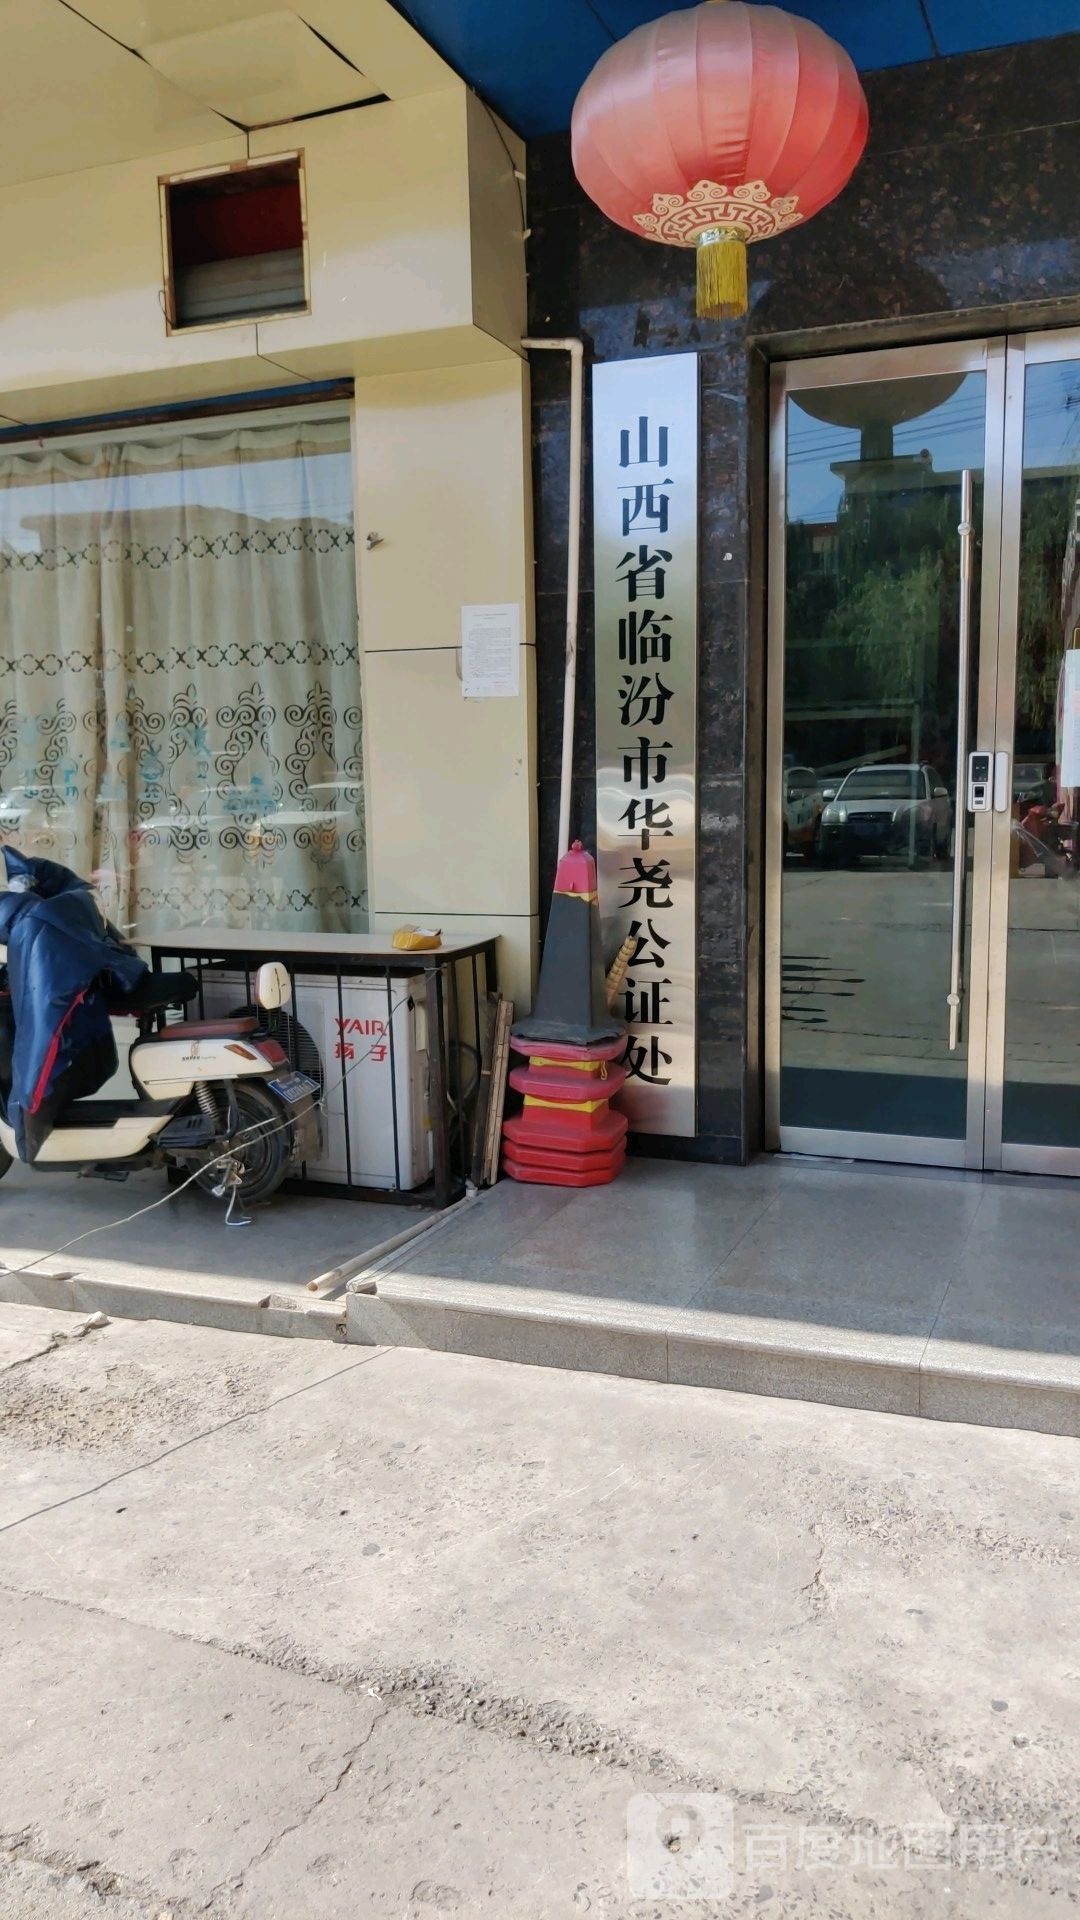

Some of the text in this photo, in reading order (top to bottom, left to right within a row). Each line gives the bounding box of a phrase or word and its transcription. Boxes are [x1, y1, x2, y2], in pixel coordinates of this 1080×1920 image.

[616, 415, 674, 1086] 山西省临汾市华尧公证处
